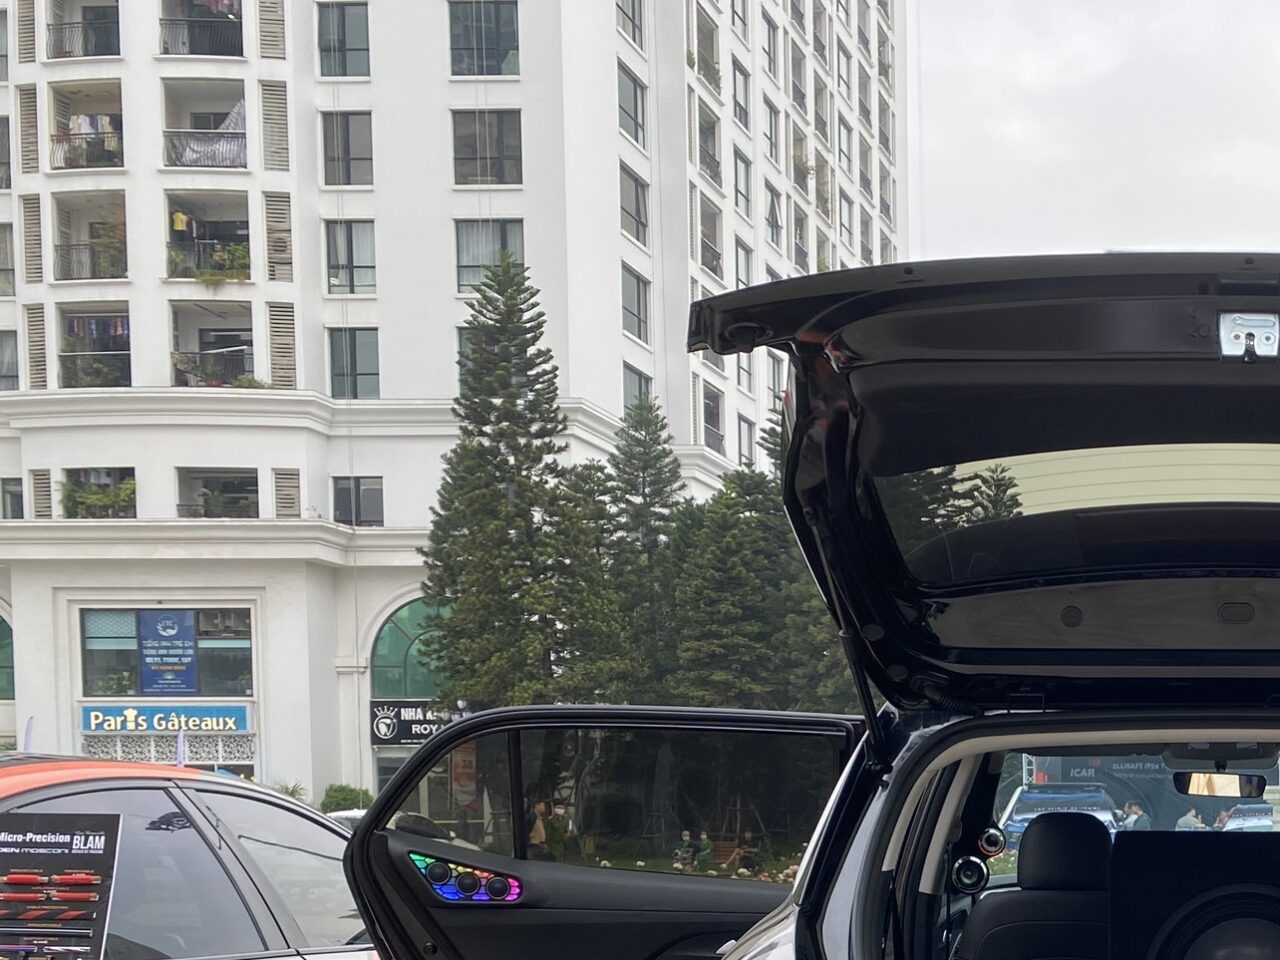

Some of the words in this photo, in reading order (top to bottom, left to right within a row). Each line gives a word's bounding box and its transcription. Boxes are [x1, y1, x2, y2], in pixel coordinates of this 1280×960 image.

[90, 708, 148, 731] Paris
[152, 712, 236, 730] Gâteaux
[400, 707, 424, 720] NHA
[1070, 768, 1096, 777] ICAR
[72, 835, 106, 850] BLAM
